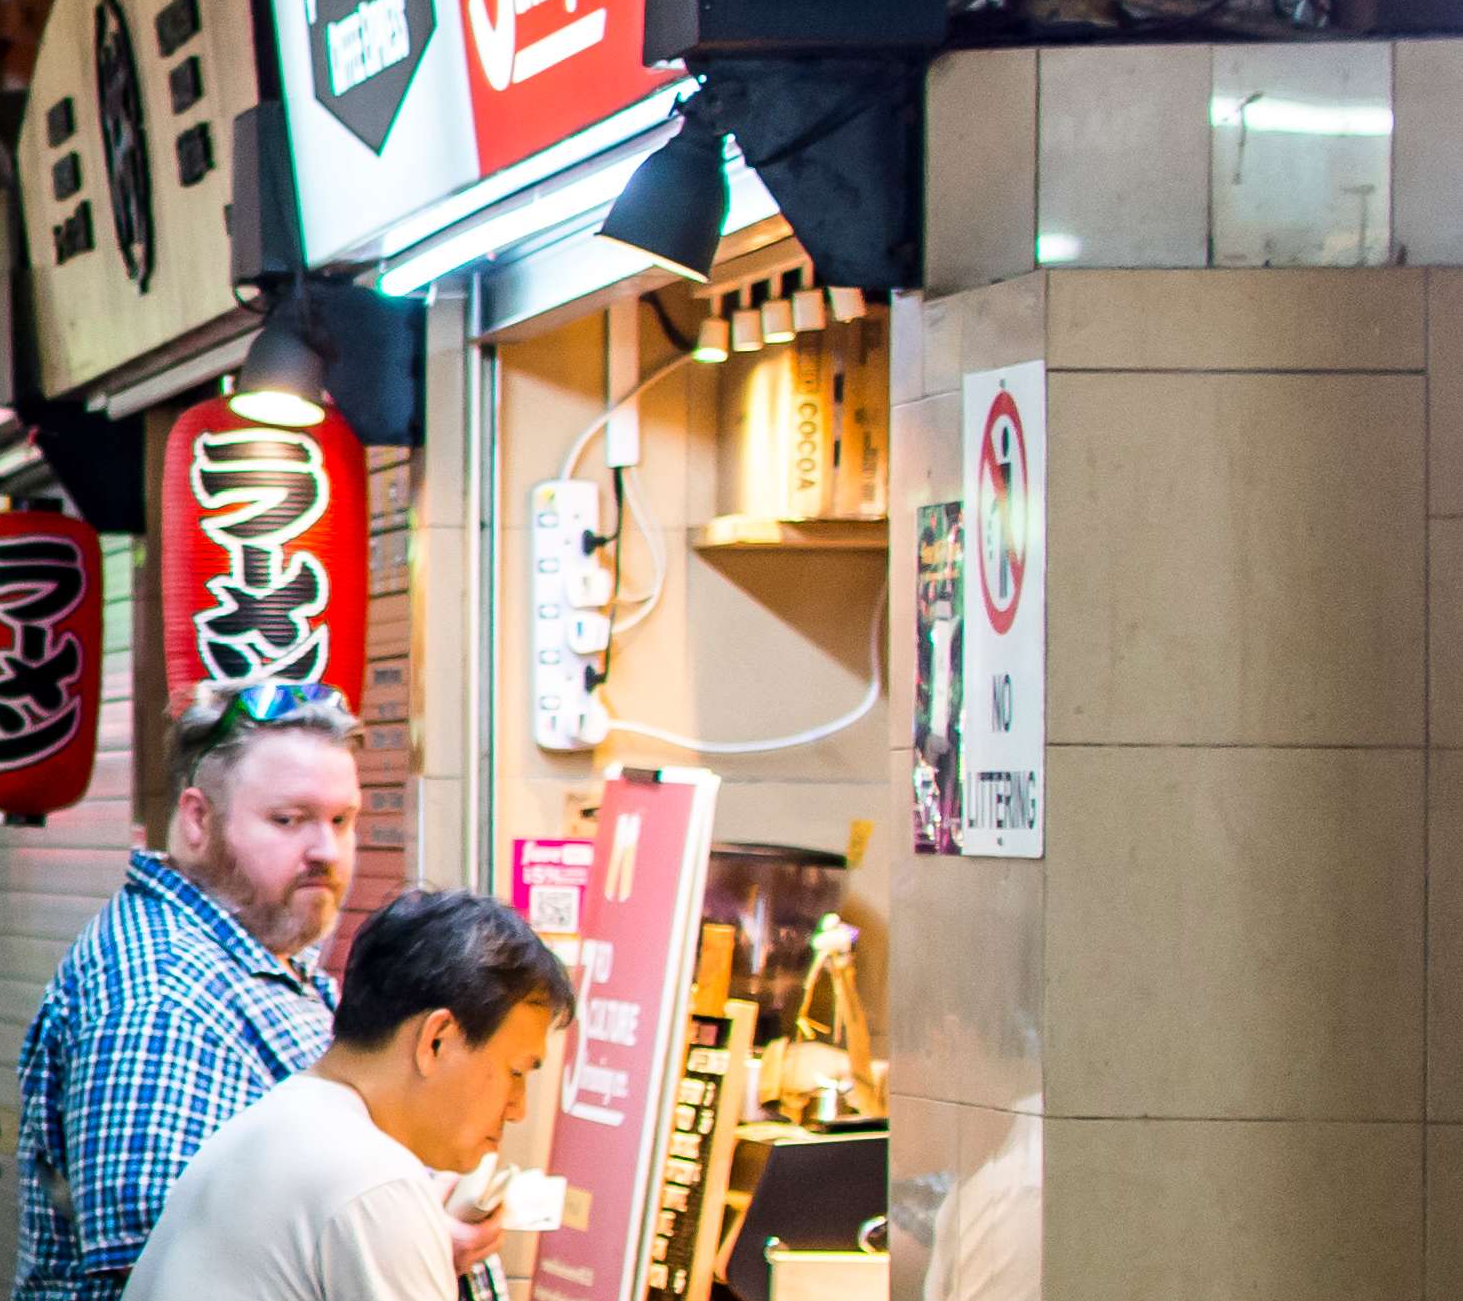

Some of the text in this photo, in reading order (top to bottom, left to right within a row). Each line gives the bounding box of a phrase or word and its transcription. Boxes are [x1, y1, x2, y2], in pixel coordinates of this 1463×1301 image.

[796, 402, 819, 493] COCOA
[190, 427, 330, 693] ラーメン
[991, 673, 1012, 732] NO
[967, 770, 1036, 830] LITTERING
